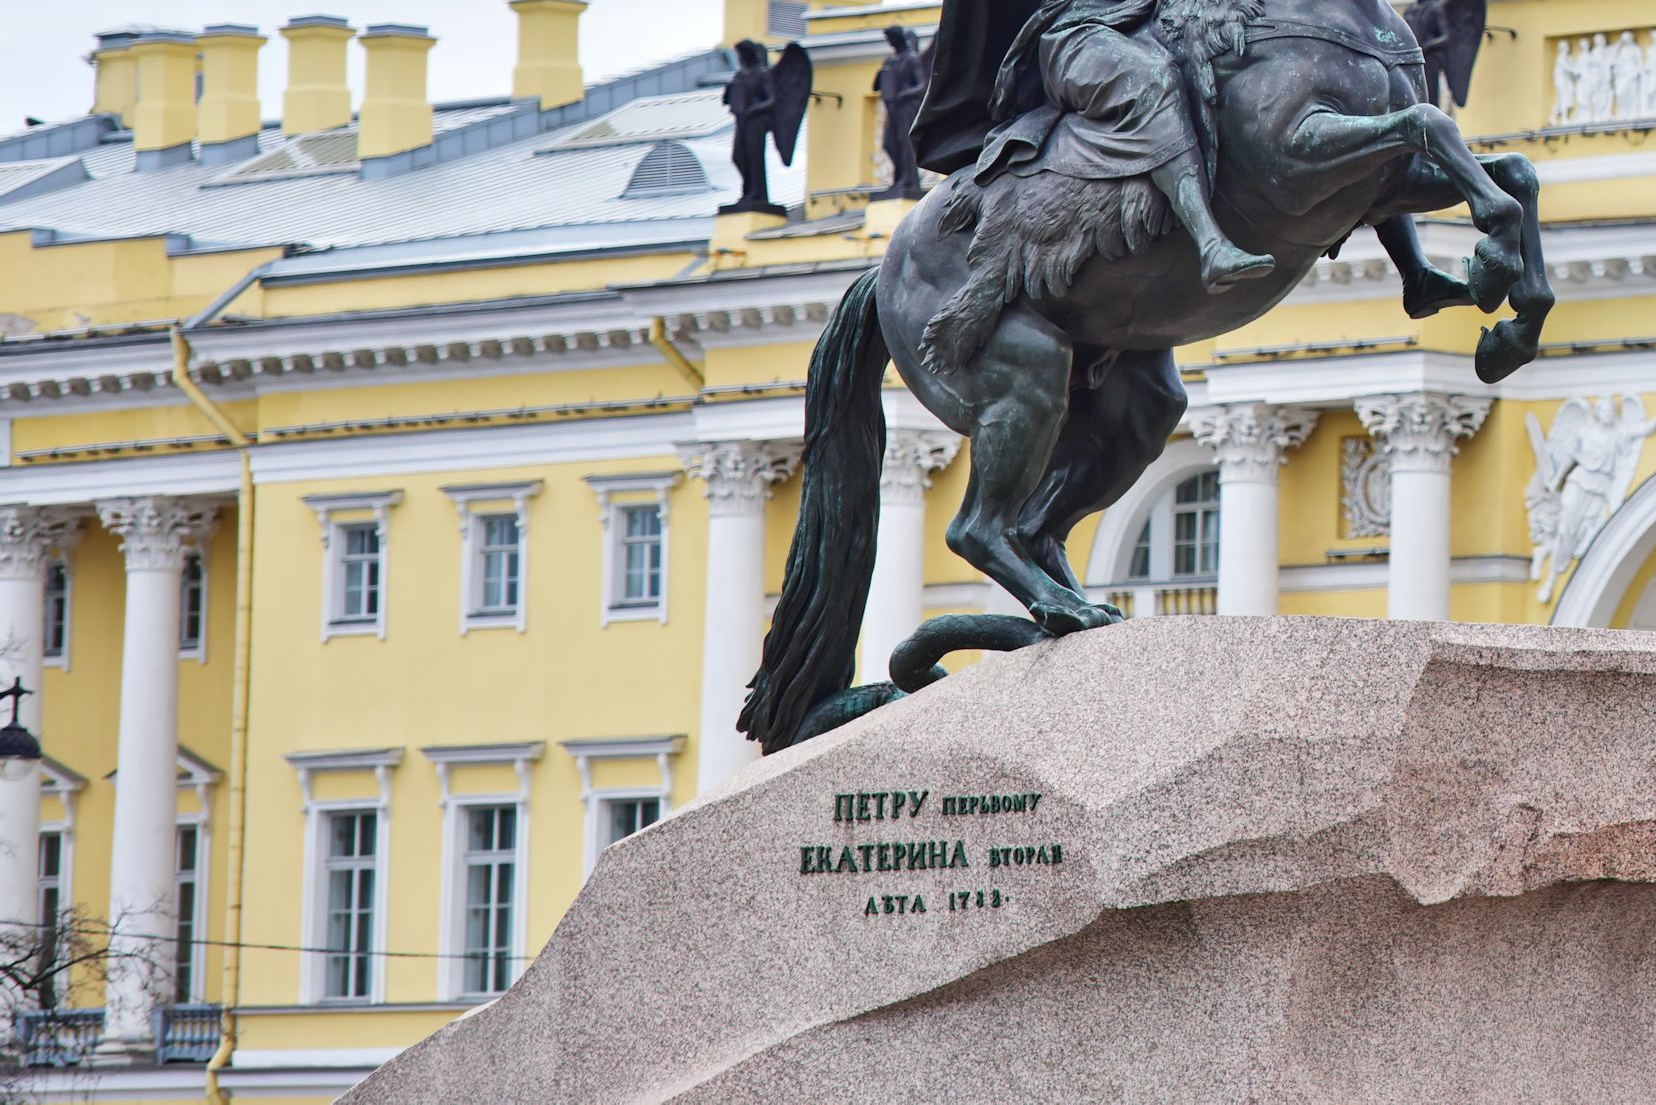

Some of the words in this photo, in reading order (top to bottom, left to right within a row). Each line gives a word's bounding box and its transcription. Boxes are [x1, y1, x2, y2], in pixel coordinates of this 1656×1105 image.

[833, 791, 929, 821] ПЕТРУ
[942, 793, 1043, 816] ПЕРЬВОМУ
[799, 840, 969, 874] ЕКАТЕРИНА
